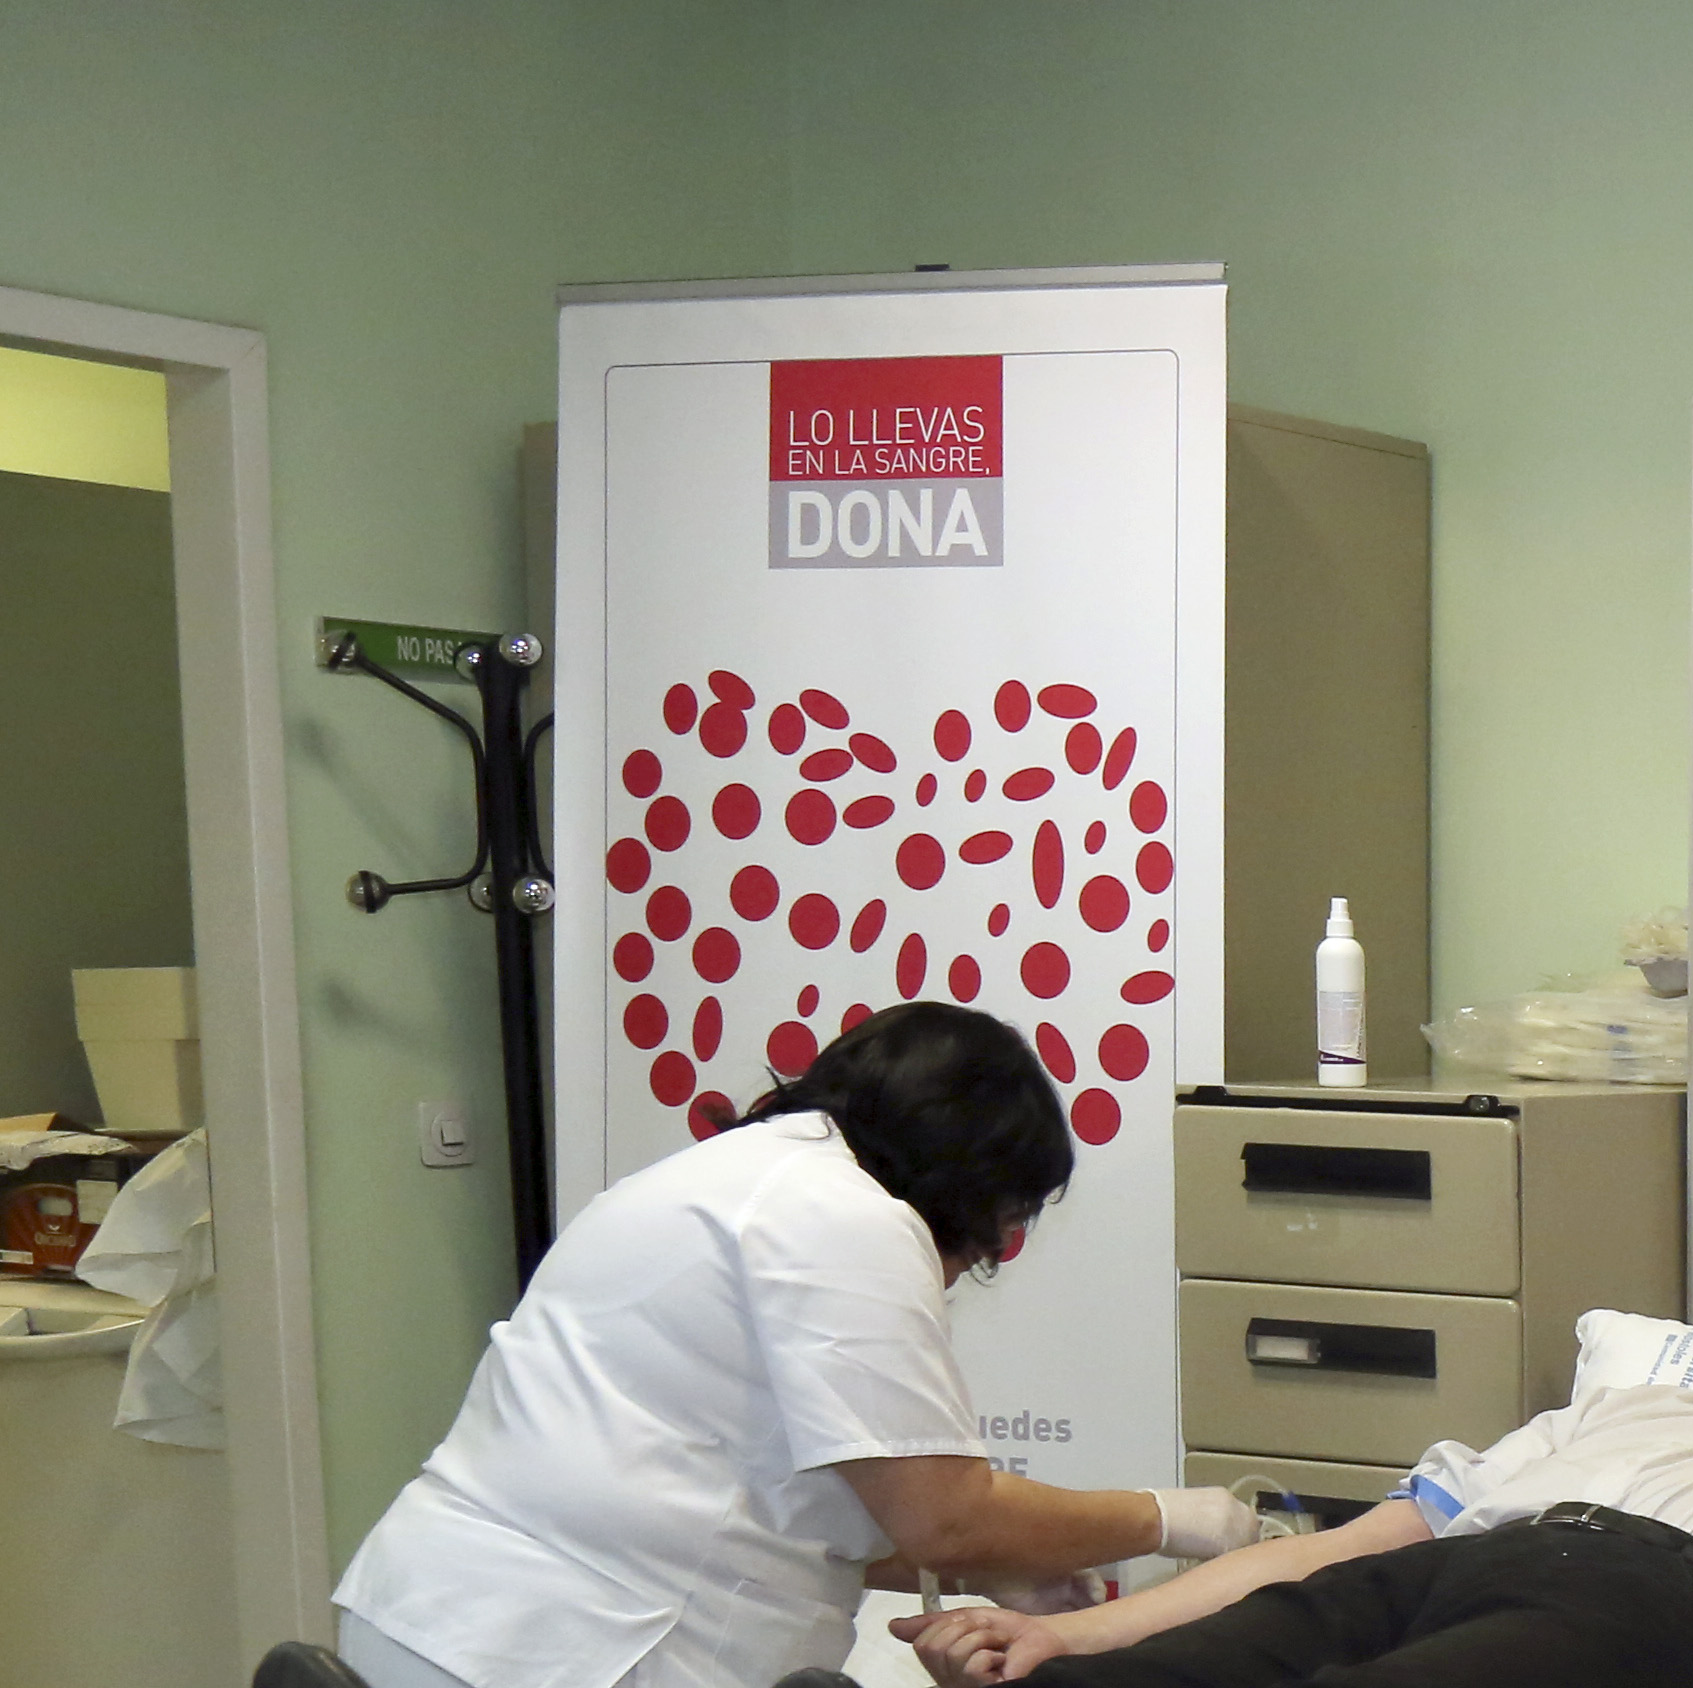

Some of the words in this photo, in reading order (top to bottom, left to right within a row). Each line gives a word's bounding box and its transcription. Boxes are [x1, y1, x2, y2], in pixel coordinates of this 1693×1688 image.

[788, 409, 834, 447] LO
[848, 406, 986, 446] LLEVAS
[788, 450, 825, 476] EN
[834, 448, 868, 474] LA
[874, 446, 992, 476] SANGRE,
[788, 487, 988, 559] DONA
[397, 636, 421, 662] NO
[425, 639, 462, 665] PAS
[979, 1409, 1072, 1443] edes
